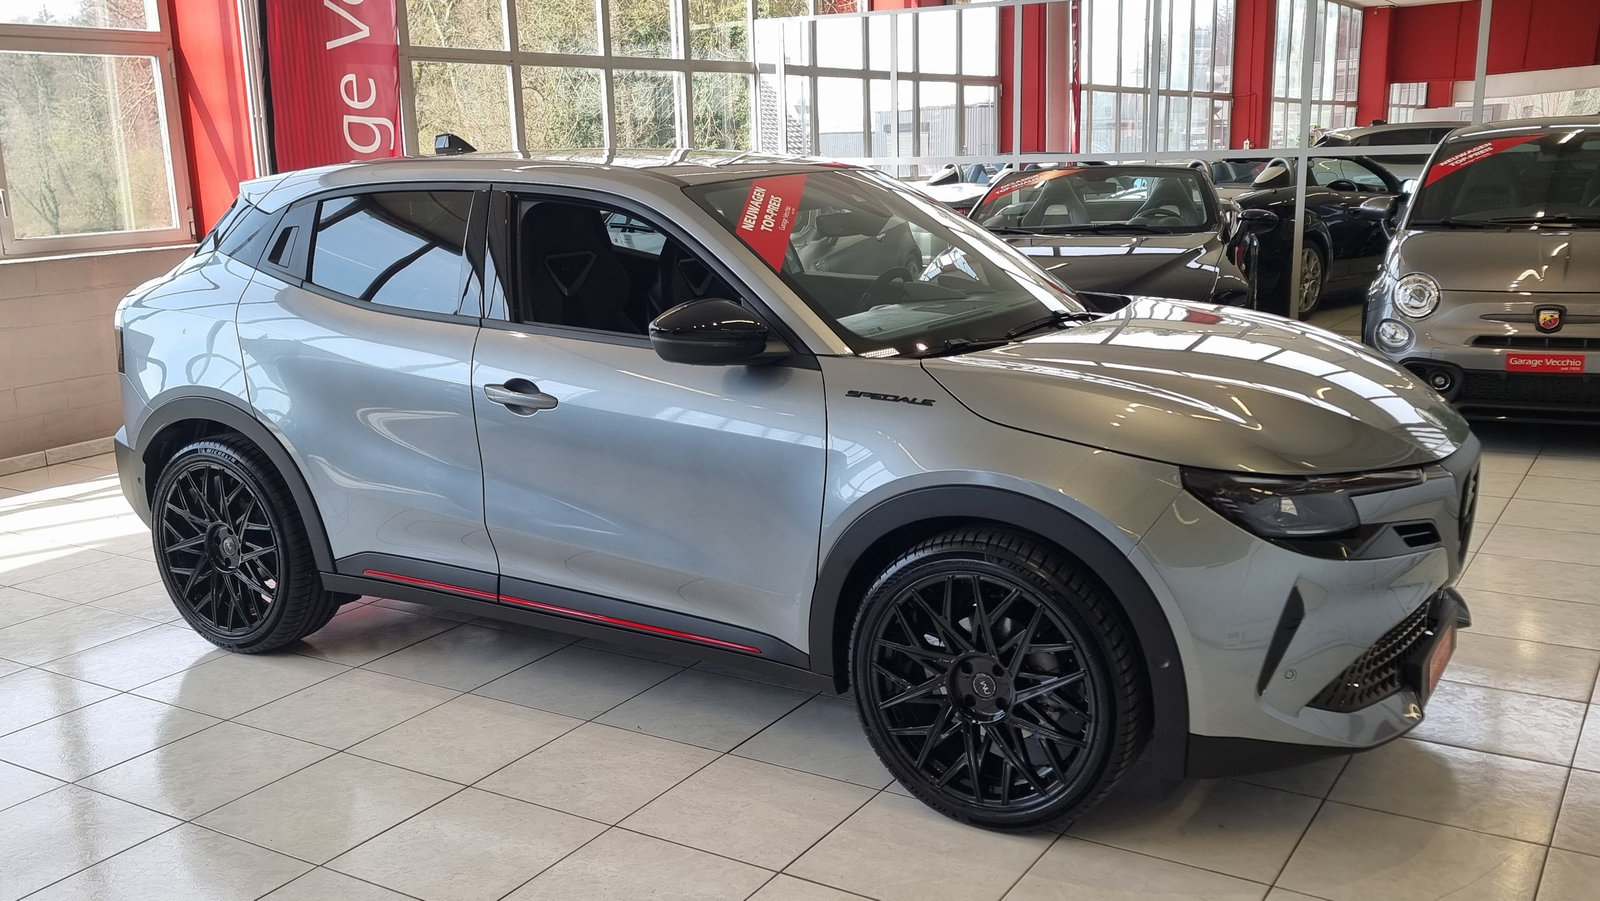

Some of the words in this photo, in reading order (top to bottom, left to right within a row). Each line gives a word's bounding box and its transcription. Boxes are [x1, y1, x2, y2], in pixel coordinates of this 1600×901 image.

[323, 0, 370, 50] V
[1440, 142, 1492, 166] NEUWAGEN
[1449, 147, 1493, 166] TOP-PREIS
[741, 186, 767, 232] NEUWAGEN
[760, 194, 782, 232] TOP-PREIS
[1509, 357, 1543, 367] Garage
[1545, 358, 1581, 366] Vecchio
[845, 390, 936, 407] SPECIALE
[206, 448, 237, 463] MICHELIN
